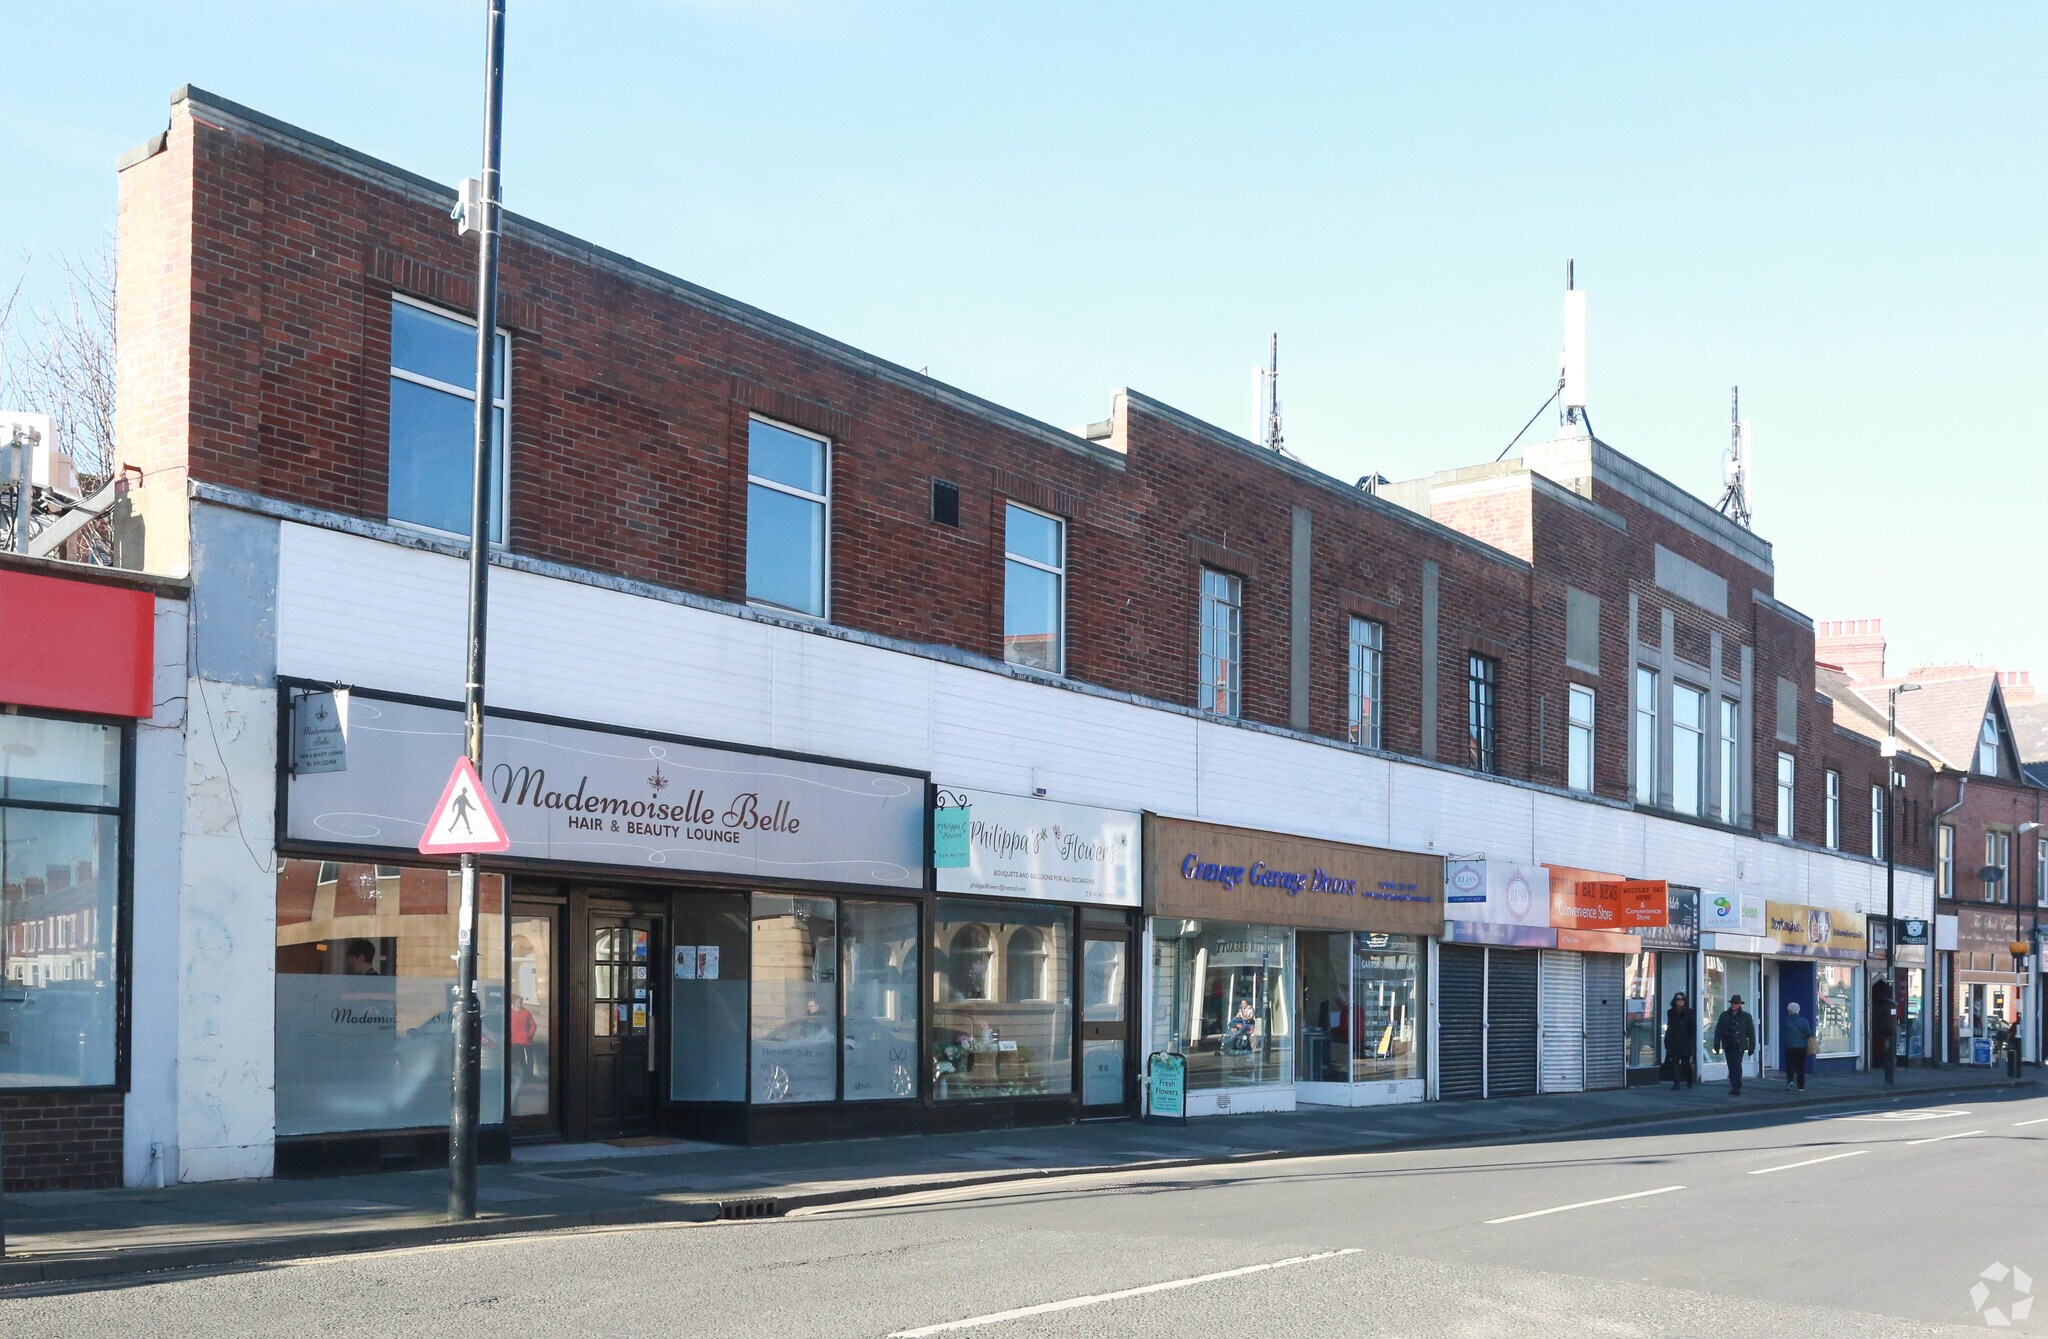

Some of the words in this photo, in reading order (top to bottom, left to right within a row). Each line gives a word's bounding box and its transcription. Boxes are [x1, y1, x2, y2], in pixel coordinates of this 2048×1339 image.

[492, 763, 715, 825] Mademoiselle
[722, 793, 800, 834] Belle
[568, 816, 603, 831] HAIR
[610, 820, 620, 832] &
[627, 822, 680, 838] BEAUTY
[686, 827, 740, 844] LOUNGE
[970, 820, 1041, 860] Philippa's
[1058, 832, 1115, 864] Flowers
[993, 870, 1019, 878] BOUQUETS
[1030, 873, 1053, 881] BALLOONS
[1070, 876, 1096, 885] OCCASIONS
[1181, 853, 1245, 891] Grange
[1250, 861, 1308, 897] Garage
[1310, 868, 1357, 896] Doors
[1511, 889, 1528, 903] BLISS
[1582, 882, 1596, 897] BAY
[1599, 884, 1618, 901] NEWS
[1558, 902, 1597, 917] Convenience
[1597, 905, 1613, 921] Store
[1640, 901, 1646, 909] &
[1155, 1086, 1179, 1096] Flowers
[1159, 1078, 1176, 1087] Fresh
